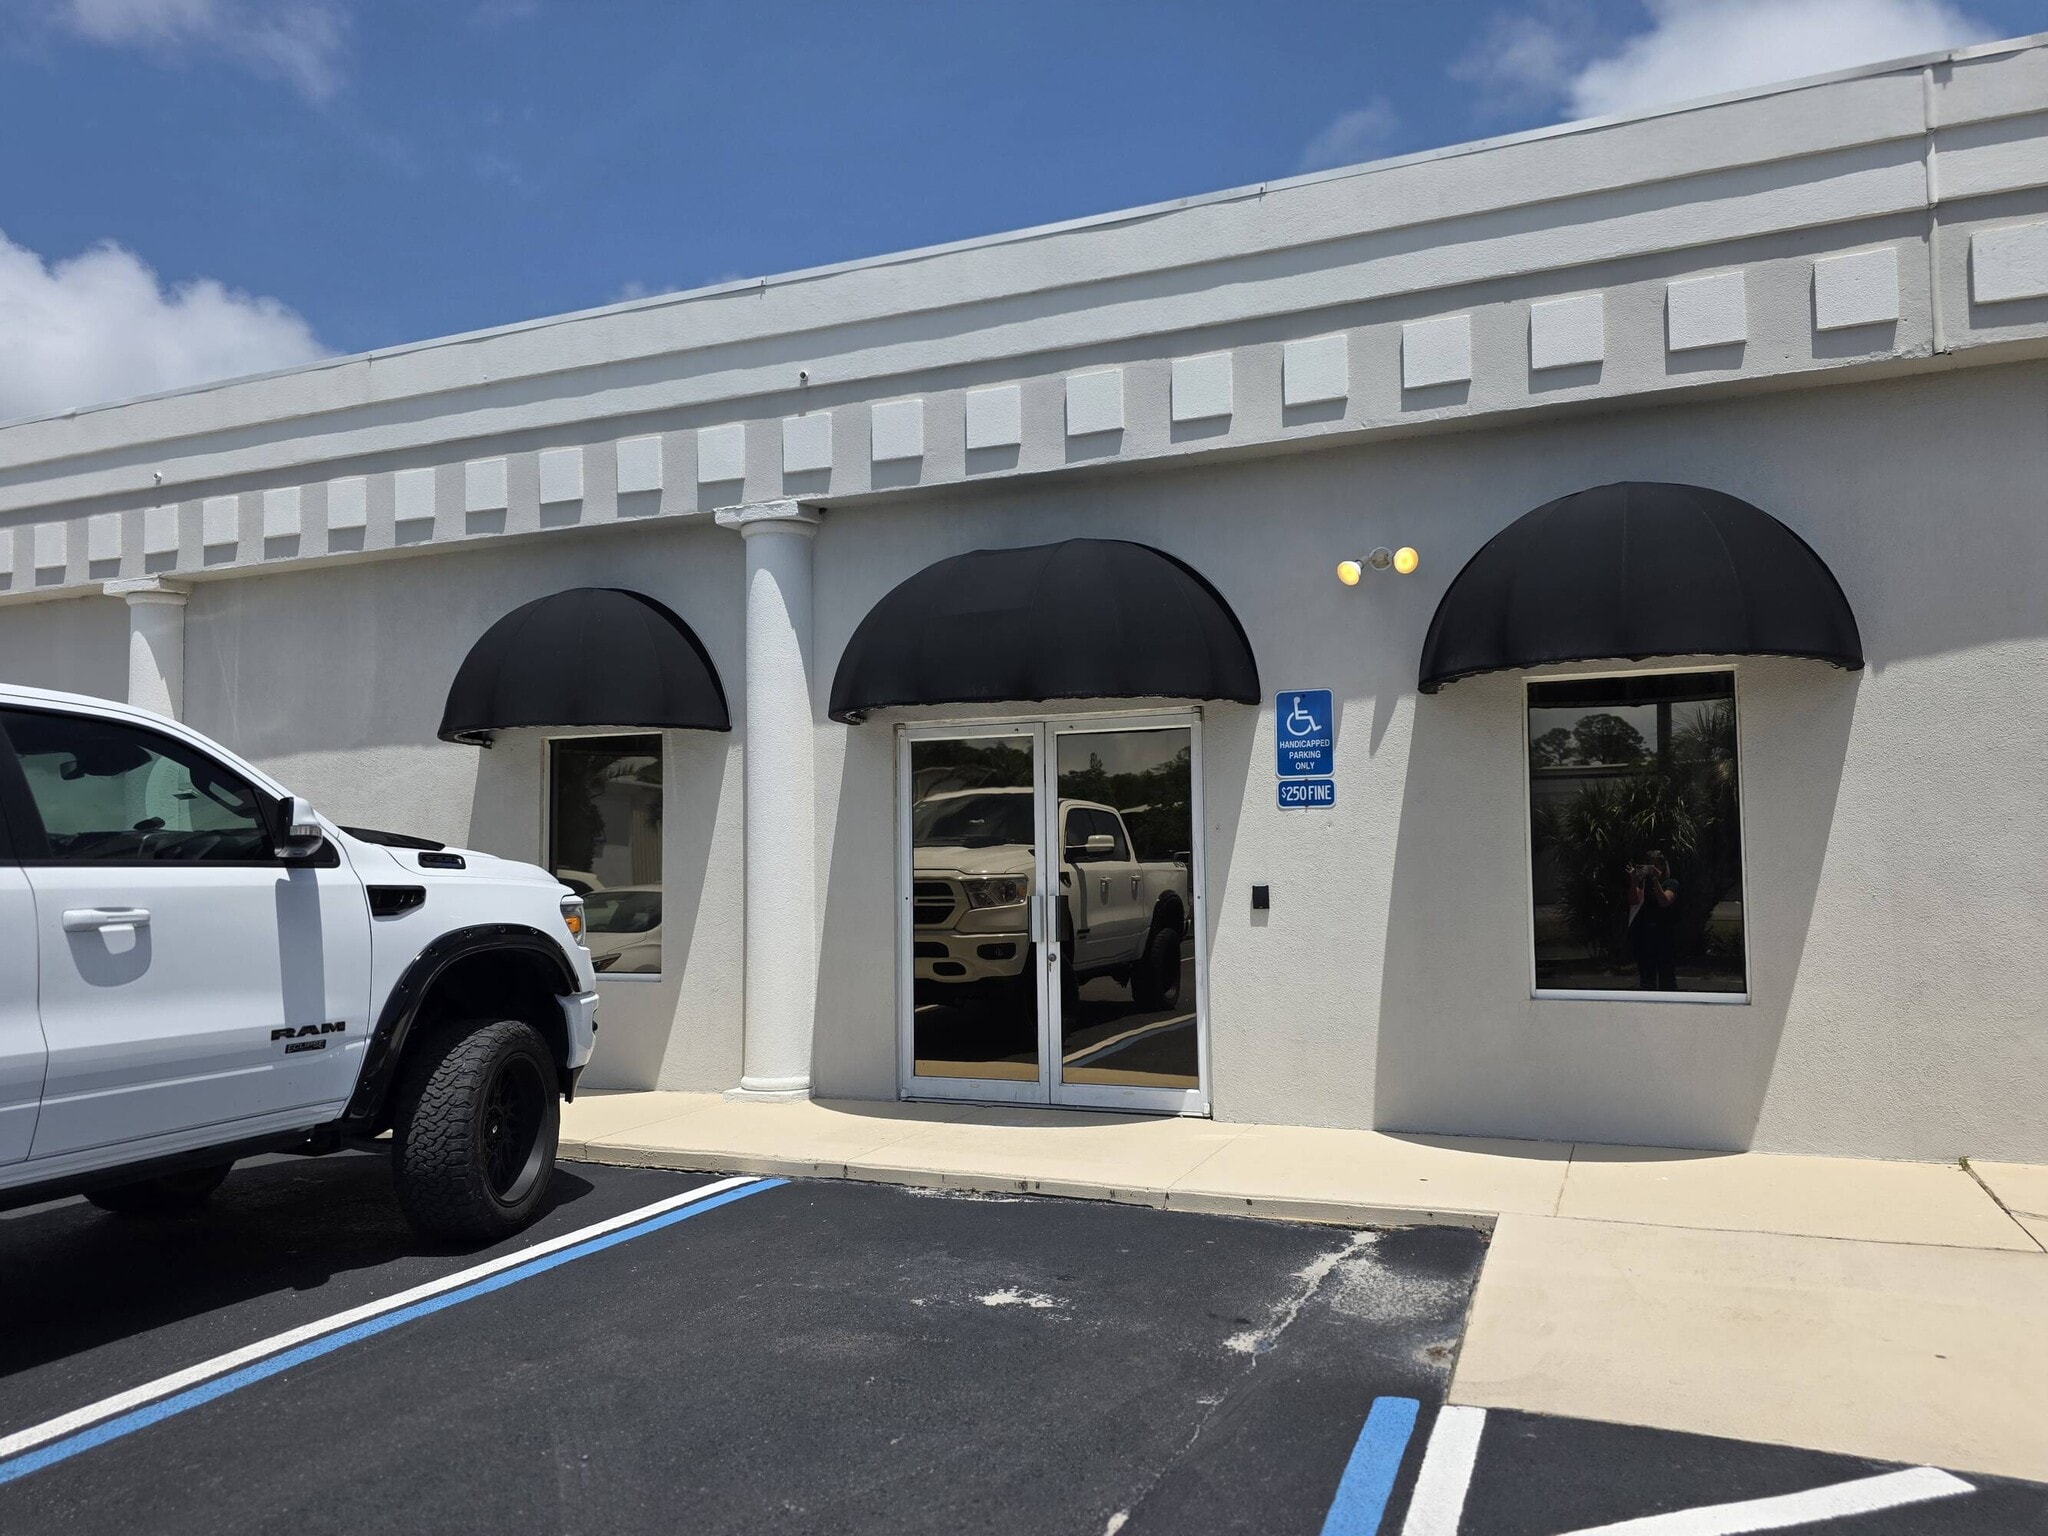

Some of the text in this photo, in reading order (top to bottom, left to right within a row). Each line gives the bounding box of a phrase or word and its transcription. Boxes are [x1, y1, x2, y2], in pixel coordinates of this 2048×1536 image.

[1279, 739, 1330, 749] HANDICAPPED
[1289, 751, 1321, 760] PARKING
[1295, 762, 1315, 770] ONLY
[1281, 785, 1332, 801] $250 FINE
[271, 1021, 345, 1041] RAM
[286, 1040, 326, 1054] ECLIPSE
